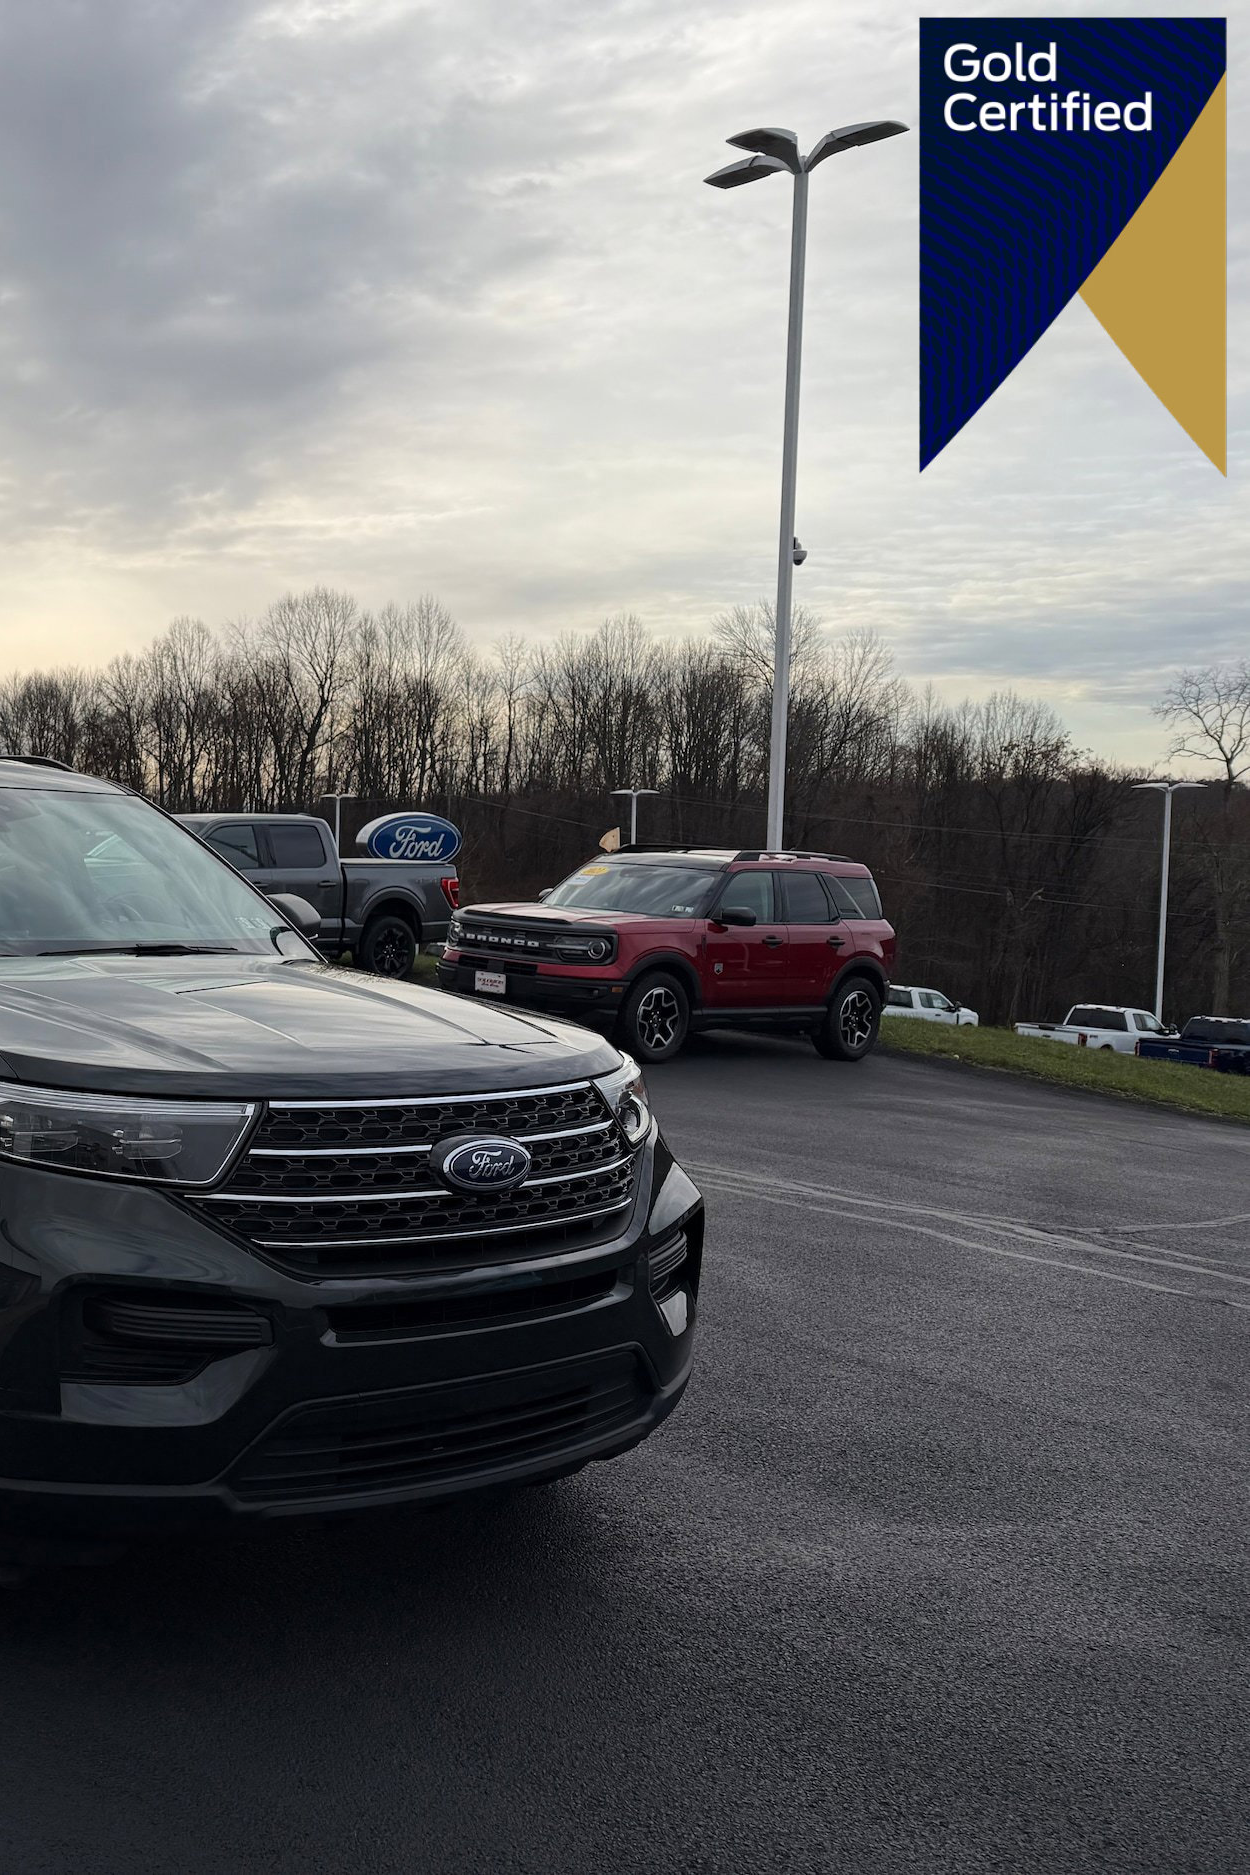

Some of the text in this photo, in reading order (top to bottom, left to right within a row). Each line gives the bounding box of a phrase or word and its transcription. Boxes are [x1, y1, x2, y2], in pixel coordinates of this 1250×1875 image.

[389, 825, 445, 859] Ford
[466, 933, 540, 948] BRONCO
[468, 1150, 515, 1179] Ford
